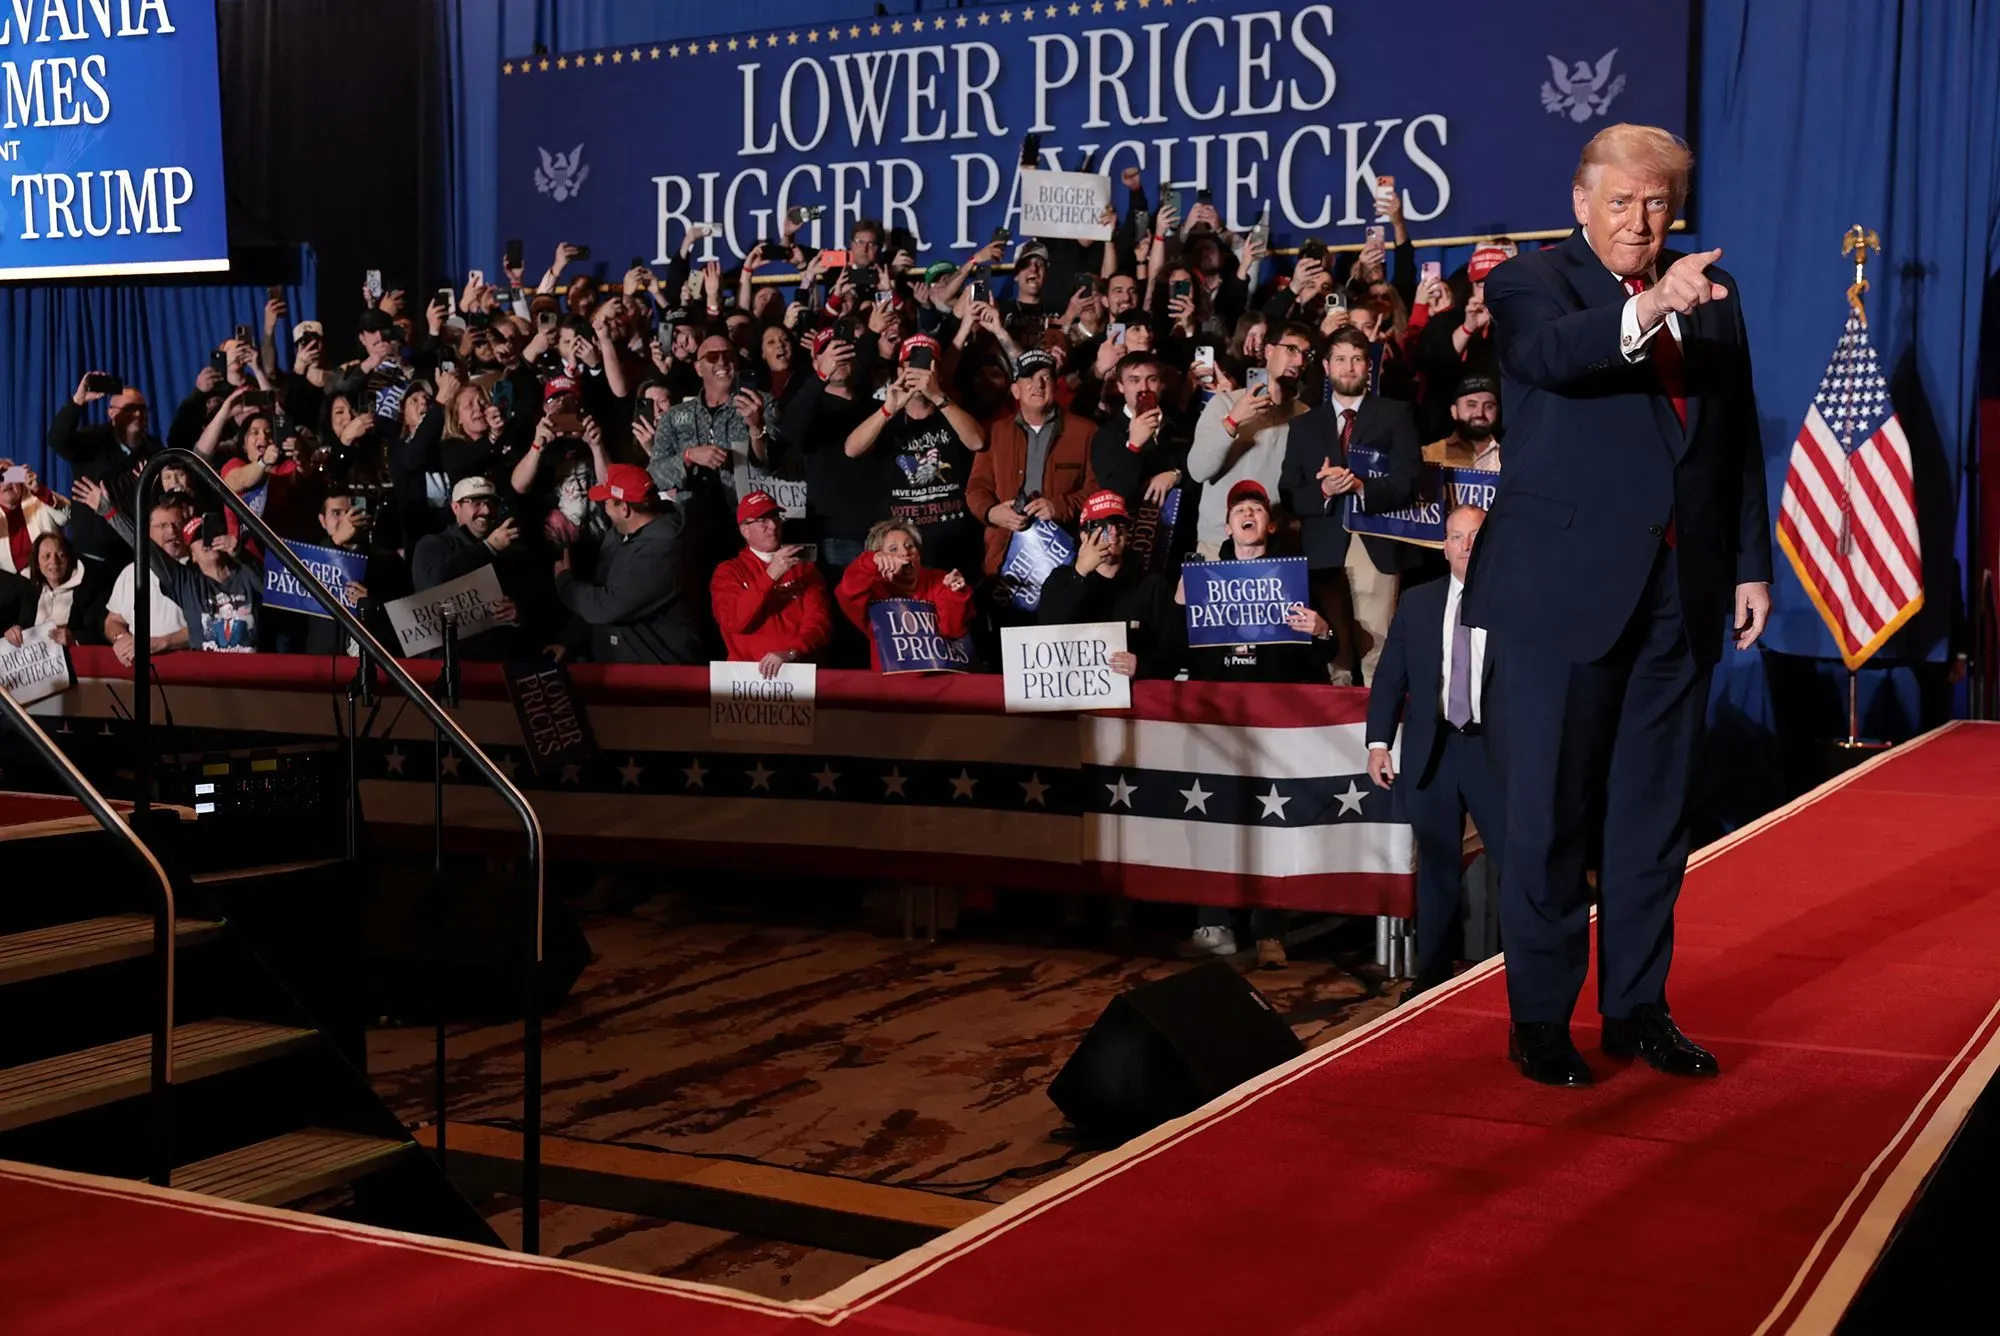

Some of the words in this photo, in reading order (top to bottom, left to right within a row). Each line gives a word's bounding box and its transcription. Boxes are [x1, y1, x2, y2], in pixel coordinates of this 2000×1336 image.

[0, 0, 175, 45] VANIA
[2, 54, 110, 129] MES
[737, 41, 1008, 156] LOWER
[1027, 4, 1337, 134] PRICES
[11, 166, 193, 239] TRUMP
[651, 158, 932, 265] BIGGER
[1039, 186, 1095, 206] BIGGER
[1024, 203, 1106, 225] PAYCHECK
[890, 505, 919, 517] VOTE
[921, 500, 962, 515] TRUMP
[1133, 507, 1159, 570] BIGG
[283, 559, 343, 587] GER
[267, 570, 357, 609] PAYCCK
[1207, 577, 1286, 603] BIGGER
[401, 600, 502, 644] PAYCECK
[886, 611, 938, 636] LOW
[2, 640, 49, 671] BIGGER
[892, 636, 969, 664] PRICES
[1021, 639, 1110, 670] LOWER
[732, 680, 795, 702] BIGGER
[1023, 668, 1111, 700] PRICES
[516, 673, 561, 755] PRICES
[538, 668, 582, 749] LOWER
[715, 701, 811, 727] PAYCHECKS
